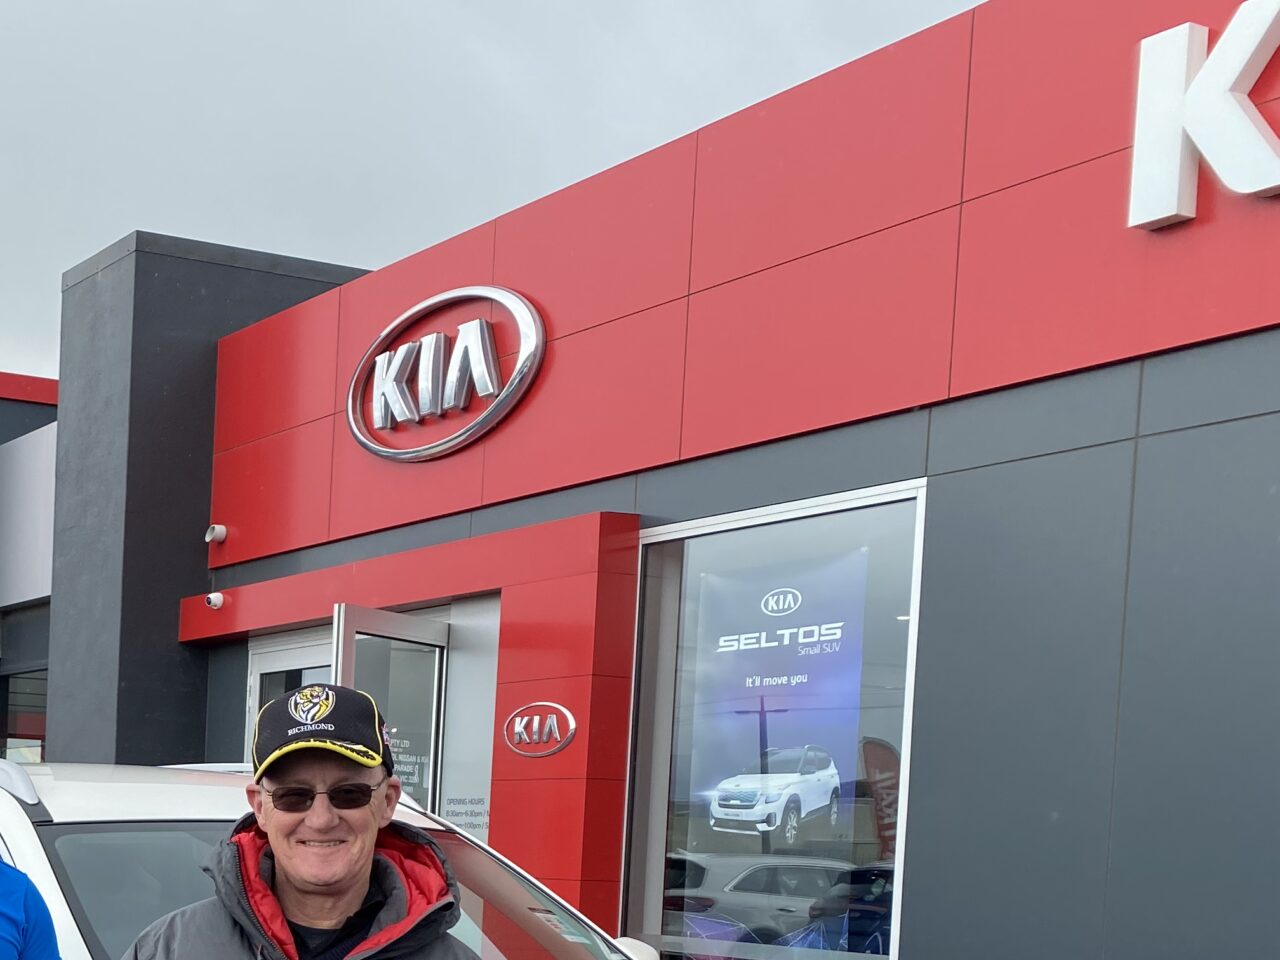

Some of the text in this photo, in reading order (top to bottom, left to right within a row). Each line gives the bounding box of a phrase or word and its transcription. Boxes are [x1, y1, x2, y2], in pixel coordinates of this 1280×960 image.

[373, 318, 498, 431] KIA
[768, 593, 796, 611] KIA
[715, 621, 845, 653] SELTOS
[798, 642, 841, 656] Small SUV
[746, 673, 808, 688] It'll move you
[287, 723, 335, 736] RICHMOND
[514, 714, 561, 745] KIA
